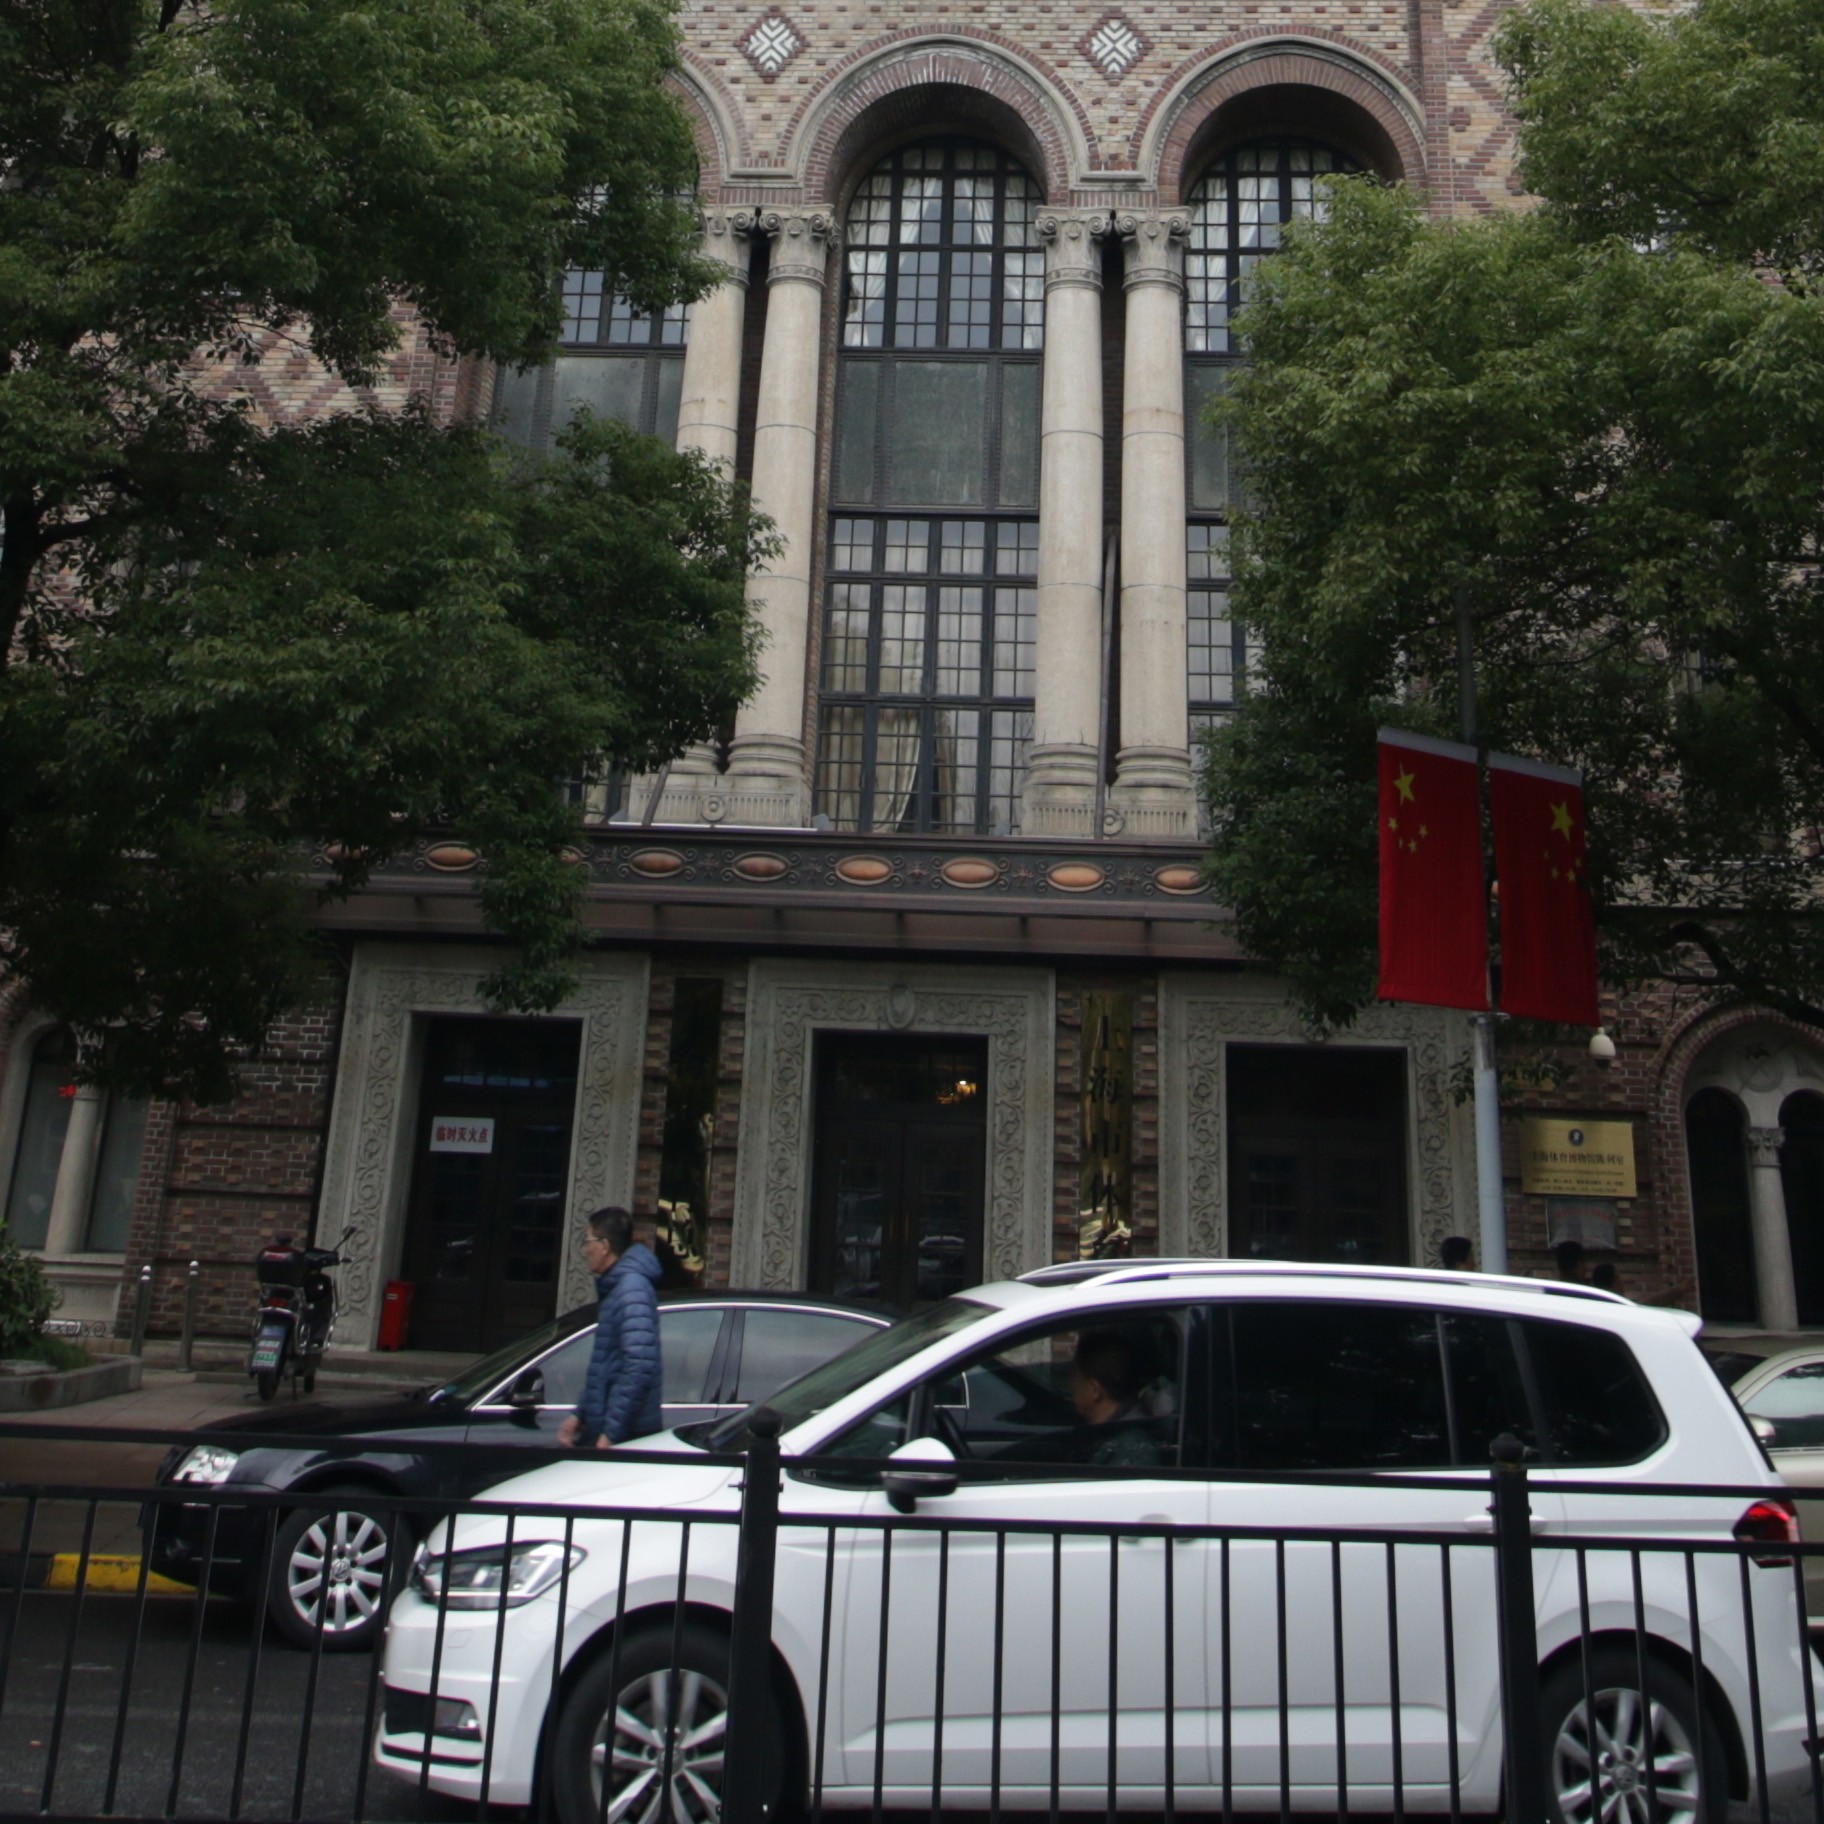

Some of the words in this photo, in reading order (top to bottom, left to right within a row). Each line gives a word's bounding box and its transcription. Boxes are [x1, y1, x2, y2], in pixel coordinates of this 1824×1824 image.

[436, 1124, 489, 1143] 临时灭火点
